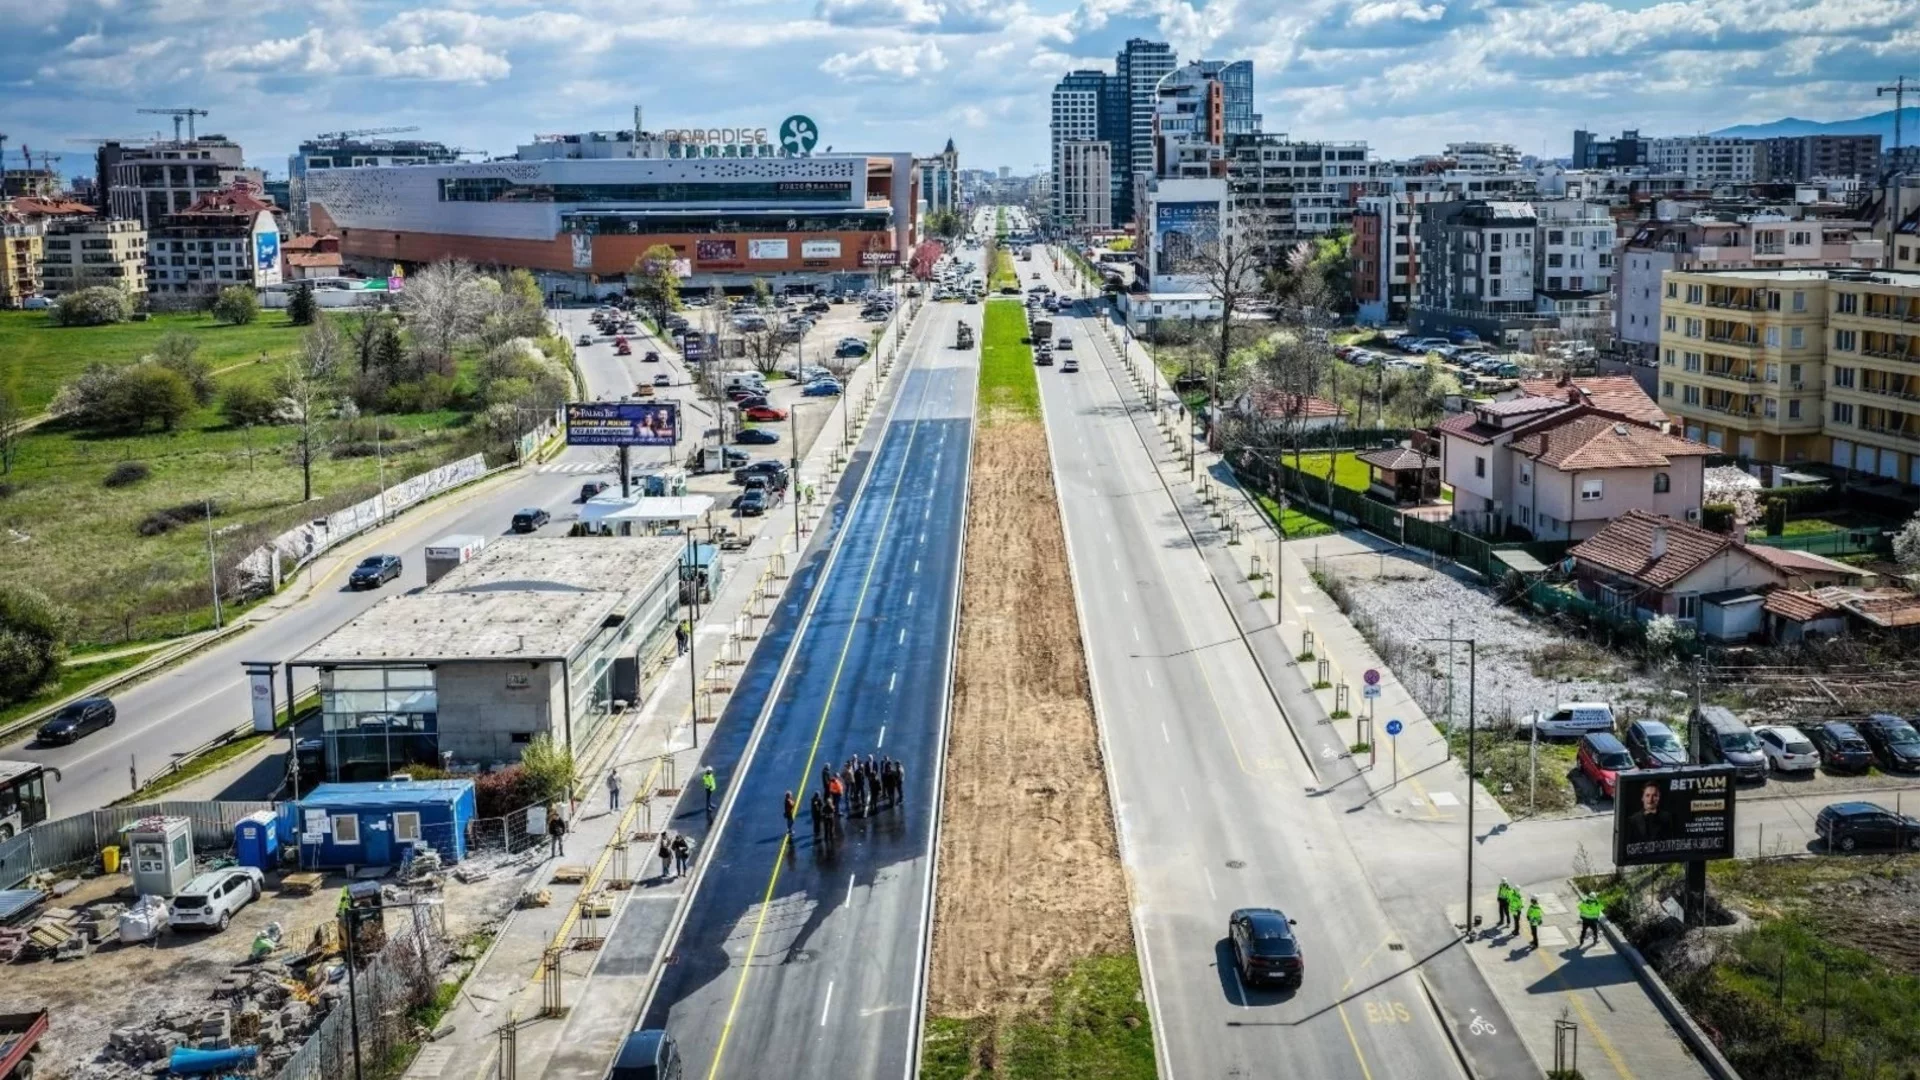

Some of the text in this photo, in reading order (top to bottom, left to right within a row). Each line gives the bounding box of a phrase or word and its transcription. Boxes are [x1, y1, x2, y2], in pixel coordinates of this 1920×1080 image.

[664, 128, 767, 144] PARADISE
[580, 408, 604, 417] PALMS
[1363, 1001, 1411, 1024] BUS
